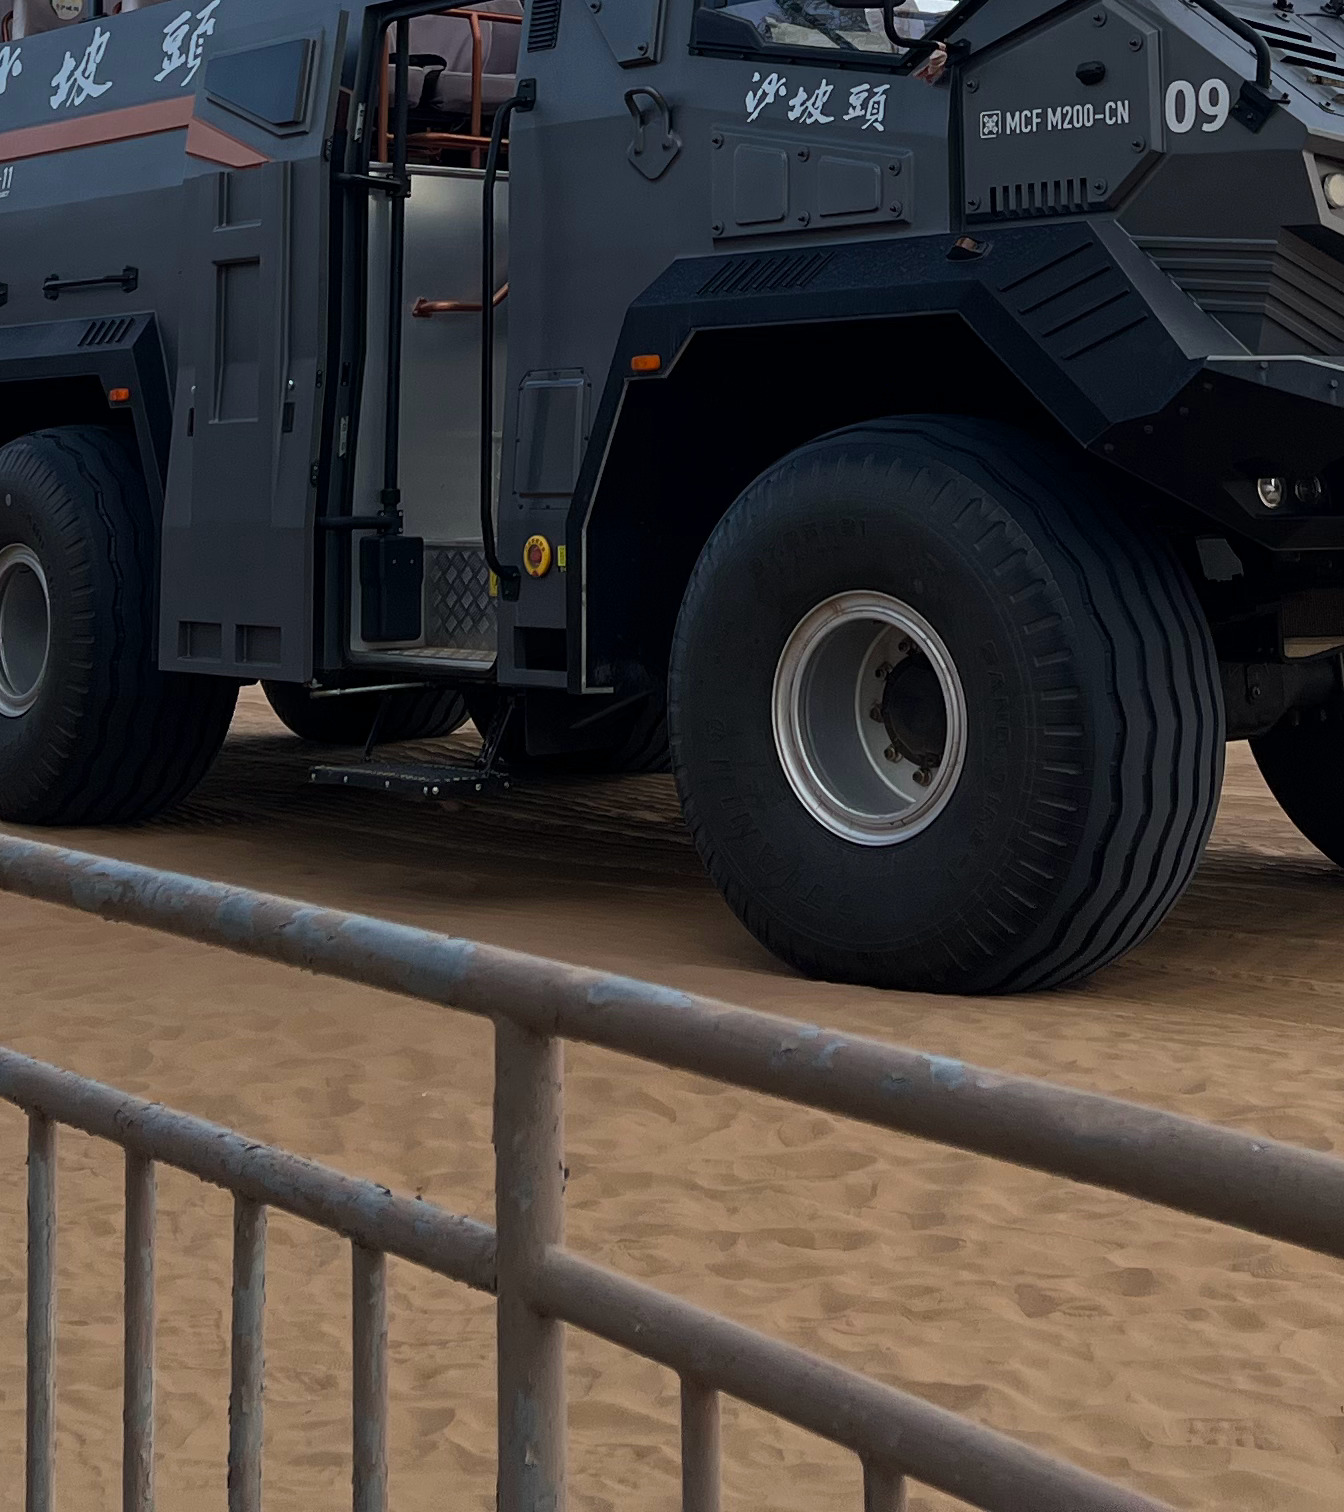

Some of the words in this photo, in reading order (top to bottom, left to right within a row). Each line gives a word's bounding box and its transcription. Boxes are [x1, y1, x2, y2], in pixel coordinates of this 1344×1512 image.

[1006, 108, 1043, 135] MCF
[1047, 100, 1130, 131] M200-CN
[1165, 78, 1230, 133] 09
